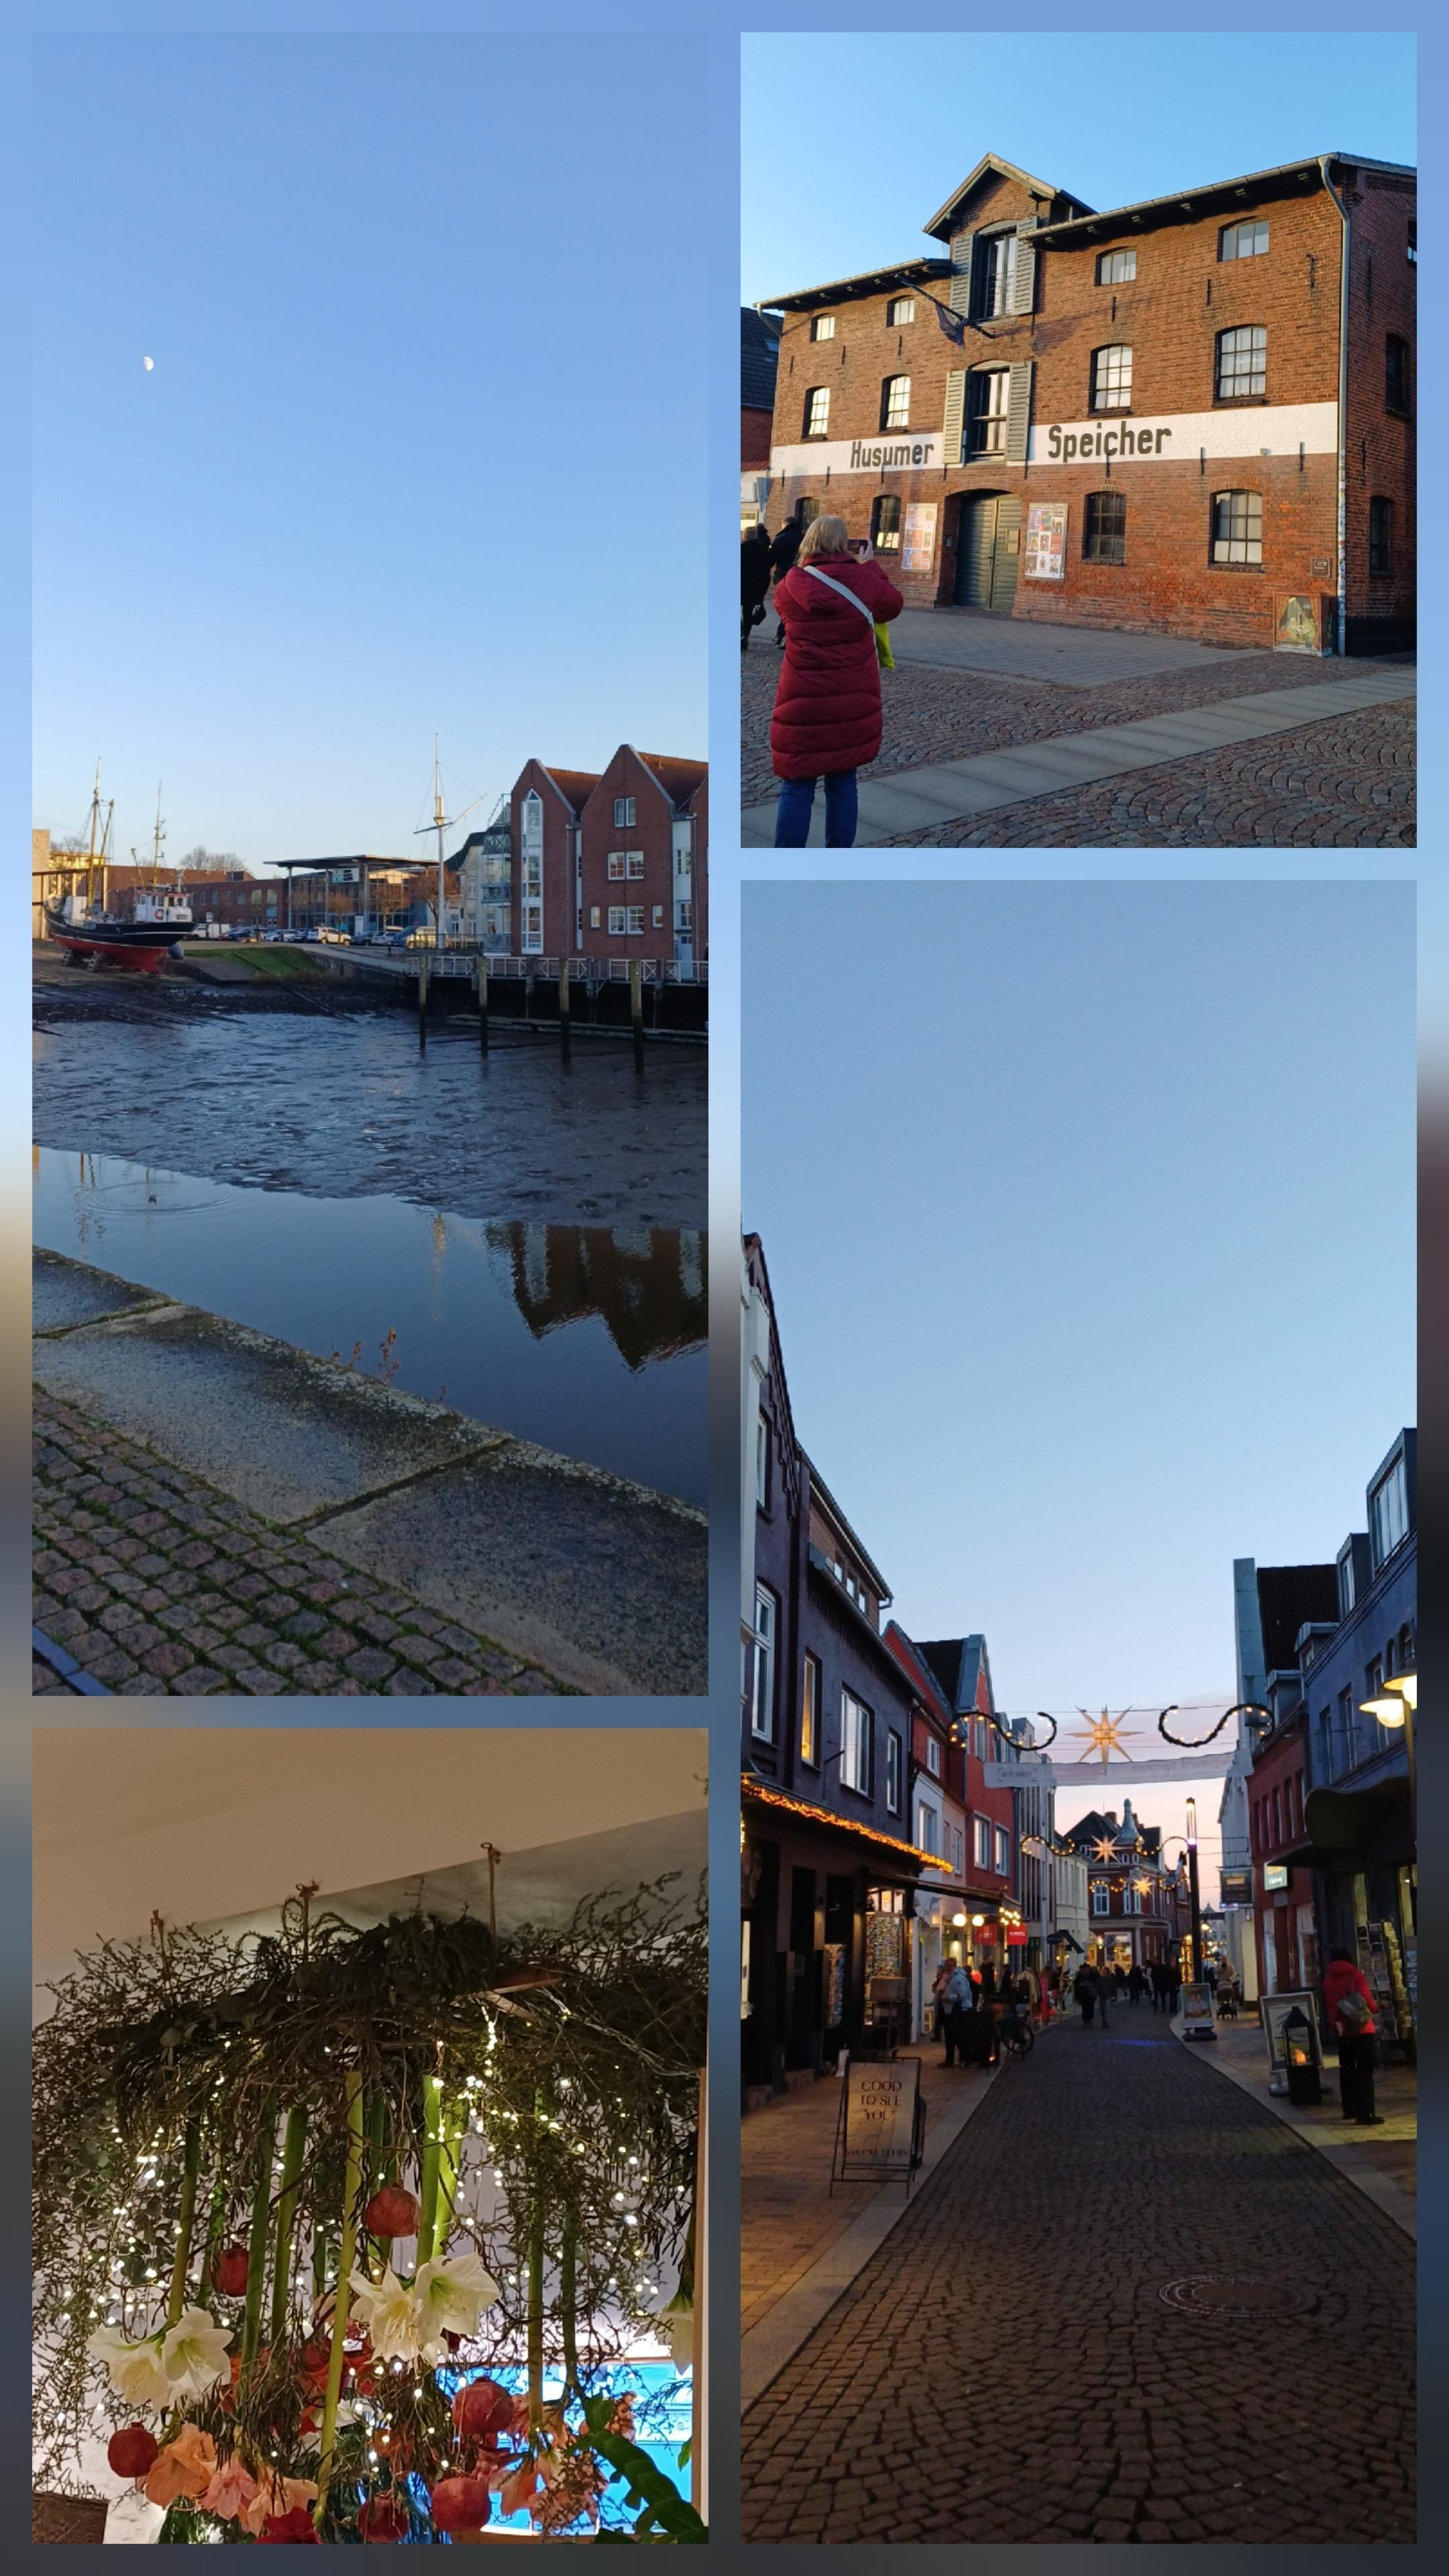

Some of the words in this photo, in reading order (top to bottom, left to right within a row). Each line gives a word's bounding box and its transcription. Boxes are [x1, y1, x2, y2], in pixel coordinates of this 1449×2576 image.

[1048, 421, 1172, 463] Speicher
[851, 440, 934, 468] Husumer
[861, 2080, 902, 2092] GOOD
[861, 2095, 876, 2106] TO
[879, 2095, 902, 2106] SEE
